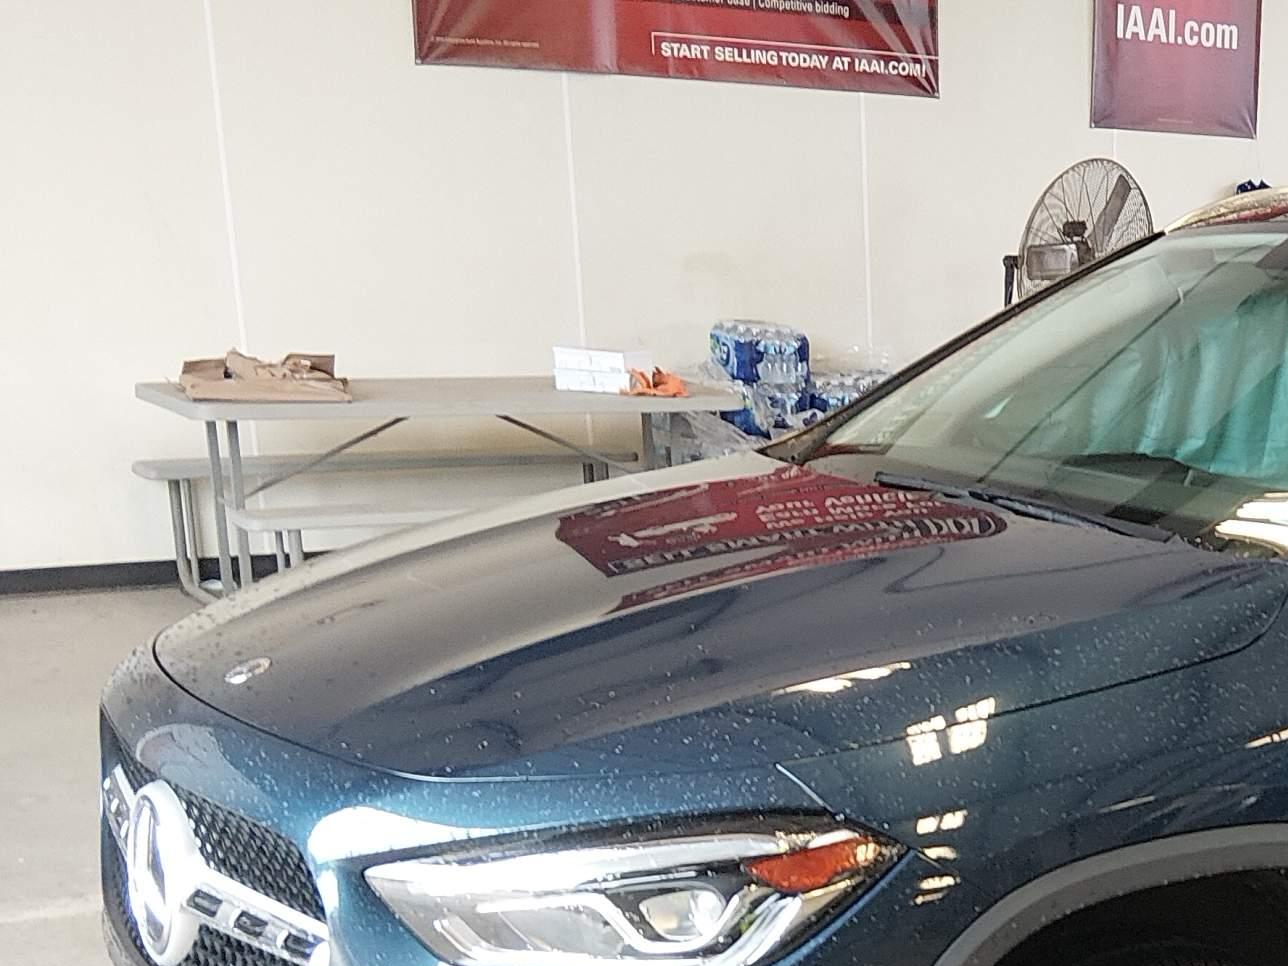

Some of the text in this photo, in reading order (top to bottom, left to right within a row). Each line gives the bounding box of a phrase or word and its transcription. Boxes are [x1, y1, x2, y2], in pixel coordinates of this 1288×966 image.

[758, 0, 814, 13] Competitive
[815, 2, 851, 19] bidding
[1116, 3, 1239, 50] IAAI.com
[660, 41, 928, 78] START SELLING TODAY AT IAAI.COM!
